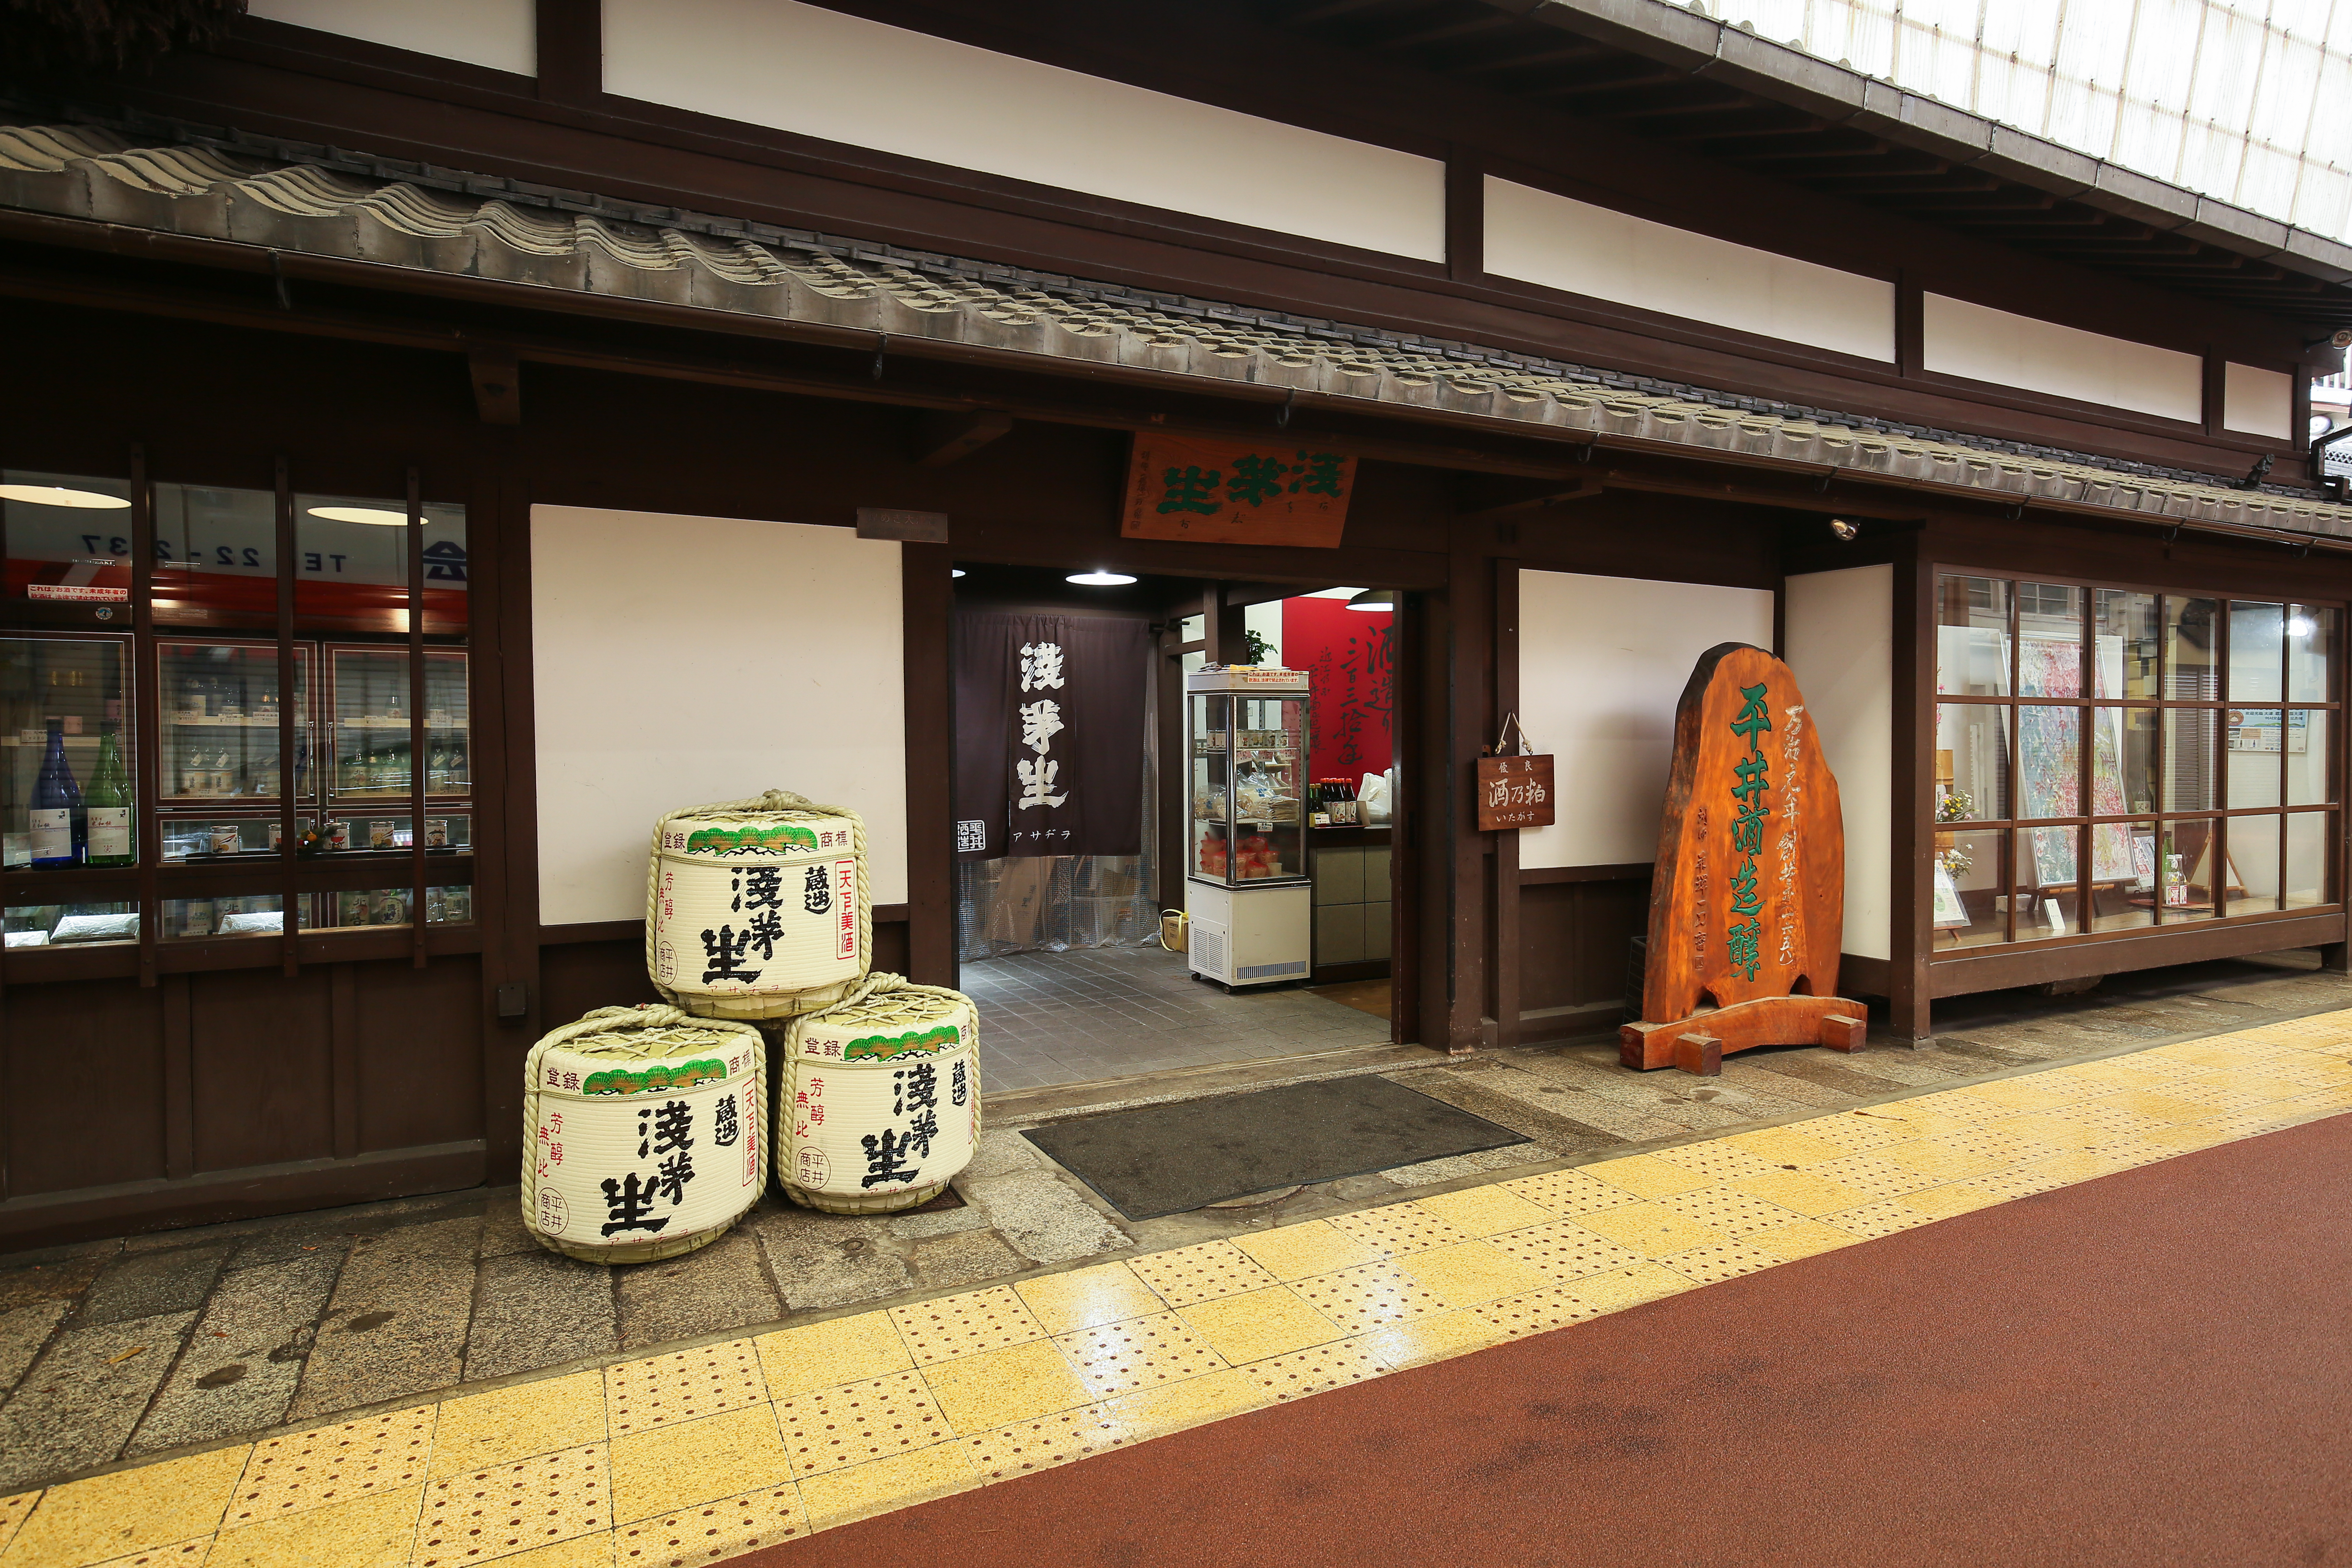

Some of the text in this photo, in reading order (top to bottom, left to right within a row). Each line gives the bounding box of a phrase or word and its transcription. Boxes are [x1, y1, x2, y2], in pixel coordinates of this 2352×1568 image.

[1499, 760, 1533, 774] 優良
[1488, 777, 1546, 808] 酒乃粕
[664, 832, 685, 850] 登録
[820, 830, 848, 848] 商標
[805, 1037, 841, 1057] 登録
[729, 1050, 751, 1076] 商標
[547, 1067, 580, 1091] 登録
[795, 1090, 810, 1138] 無比
[810, 1077, 825, 1126] 芳醇
[538, 1124, 550, 1178] 無比
[550, 1112, 564, 1166] 芳醇
